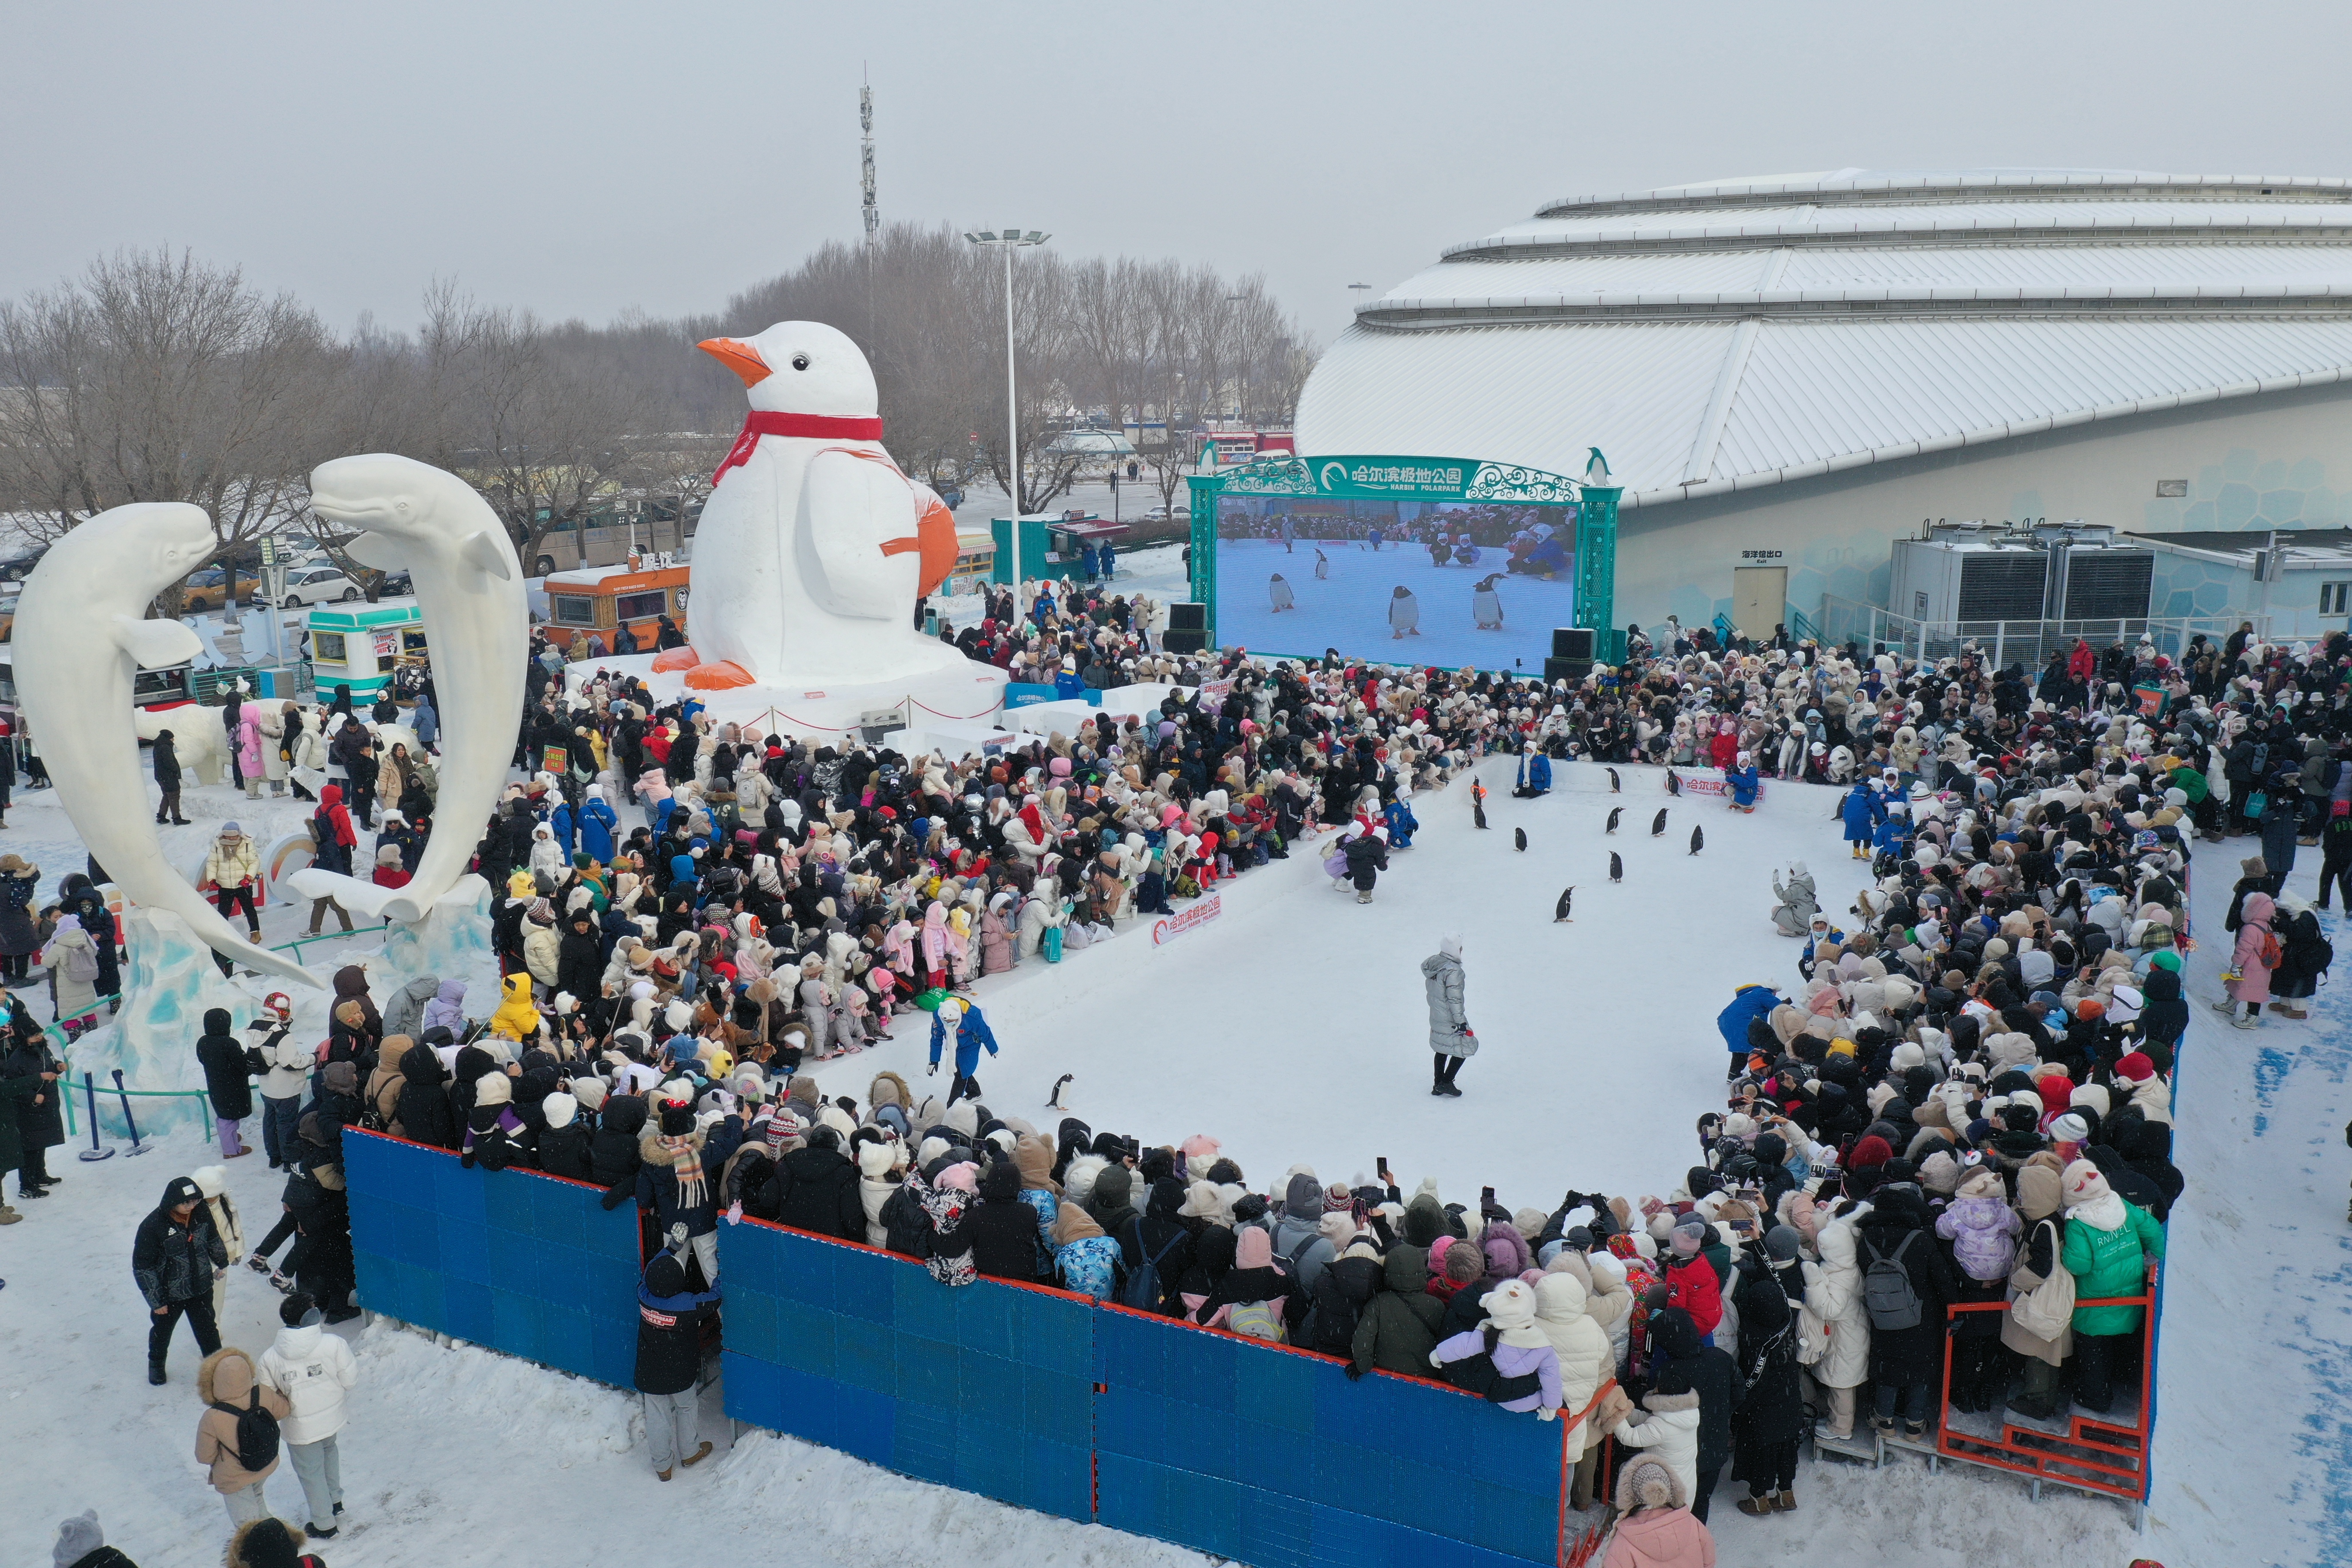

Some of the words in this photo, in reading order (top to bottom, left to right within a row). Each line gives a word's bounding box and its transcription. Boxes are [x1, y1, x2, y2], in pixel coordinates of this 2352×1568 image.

[1352, 465, 1461, 484] 哈尔滨极地公园
[1742, 550, 1782, 558] 海洋馆出口
[1169, 895, 1220, 931] 哈尔滨极地公园
[1188, 919, 1200, 928] HARBIN
[1203, 909, 1221, 921] POLARPARK
[640, 1308, 674, 1323] GINGERBREAD
[1755, 1356, 1766, 1375] MLBX
